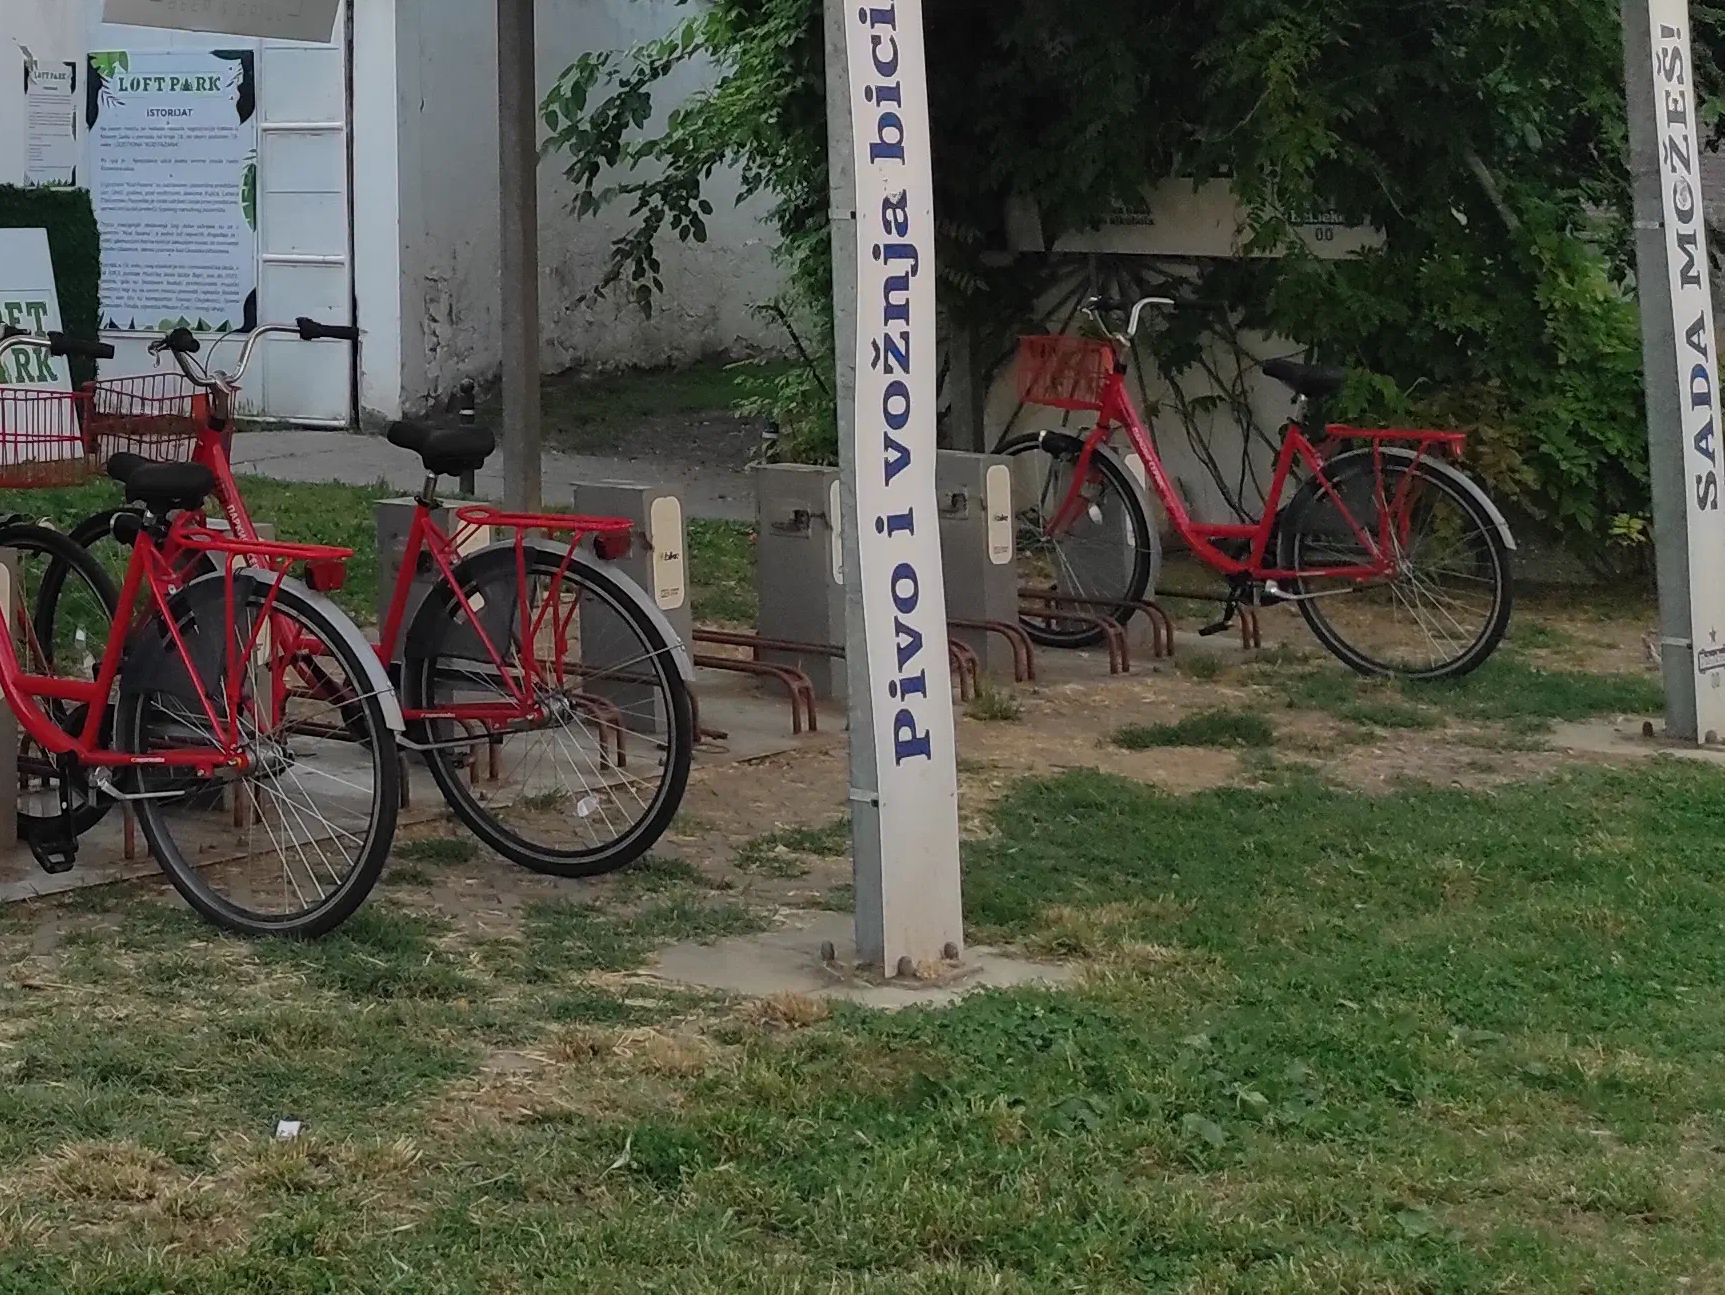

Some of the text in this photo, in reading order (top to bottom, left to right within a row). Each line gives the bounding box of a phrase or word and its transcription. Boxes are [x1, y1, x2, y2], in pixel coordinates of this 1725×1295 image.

[118, 76, 220, 92] LOFT PARK
[147, 108, 193, 117] ISTORIJAT
[1656, 23, 1719, 512] SADA MOŽEŠ!
[871, 189, 919, 486] vožnja
[875, 506, 915, 538] i
[888, 561, 932, 767] Pivo
